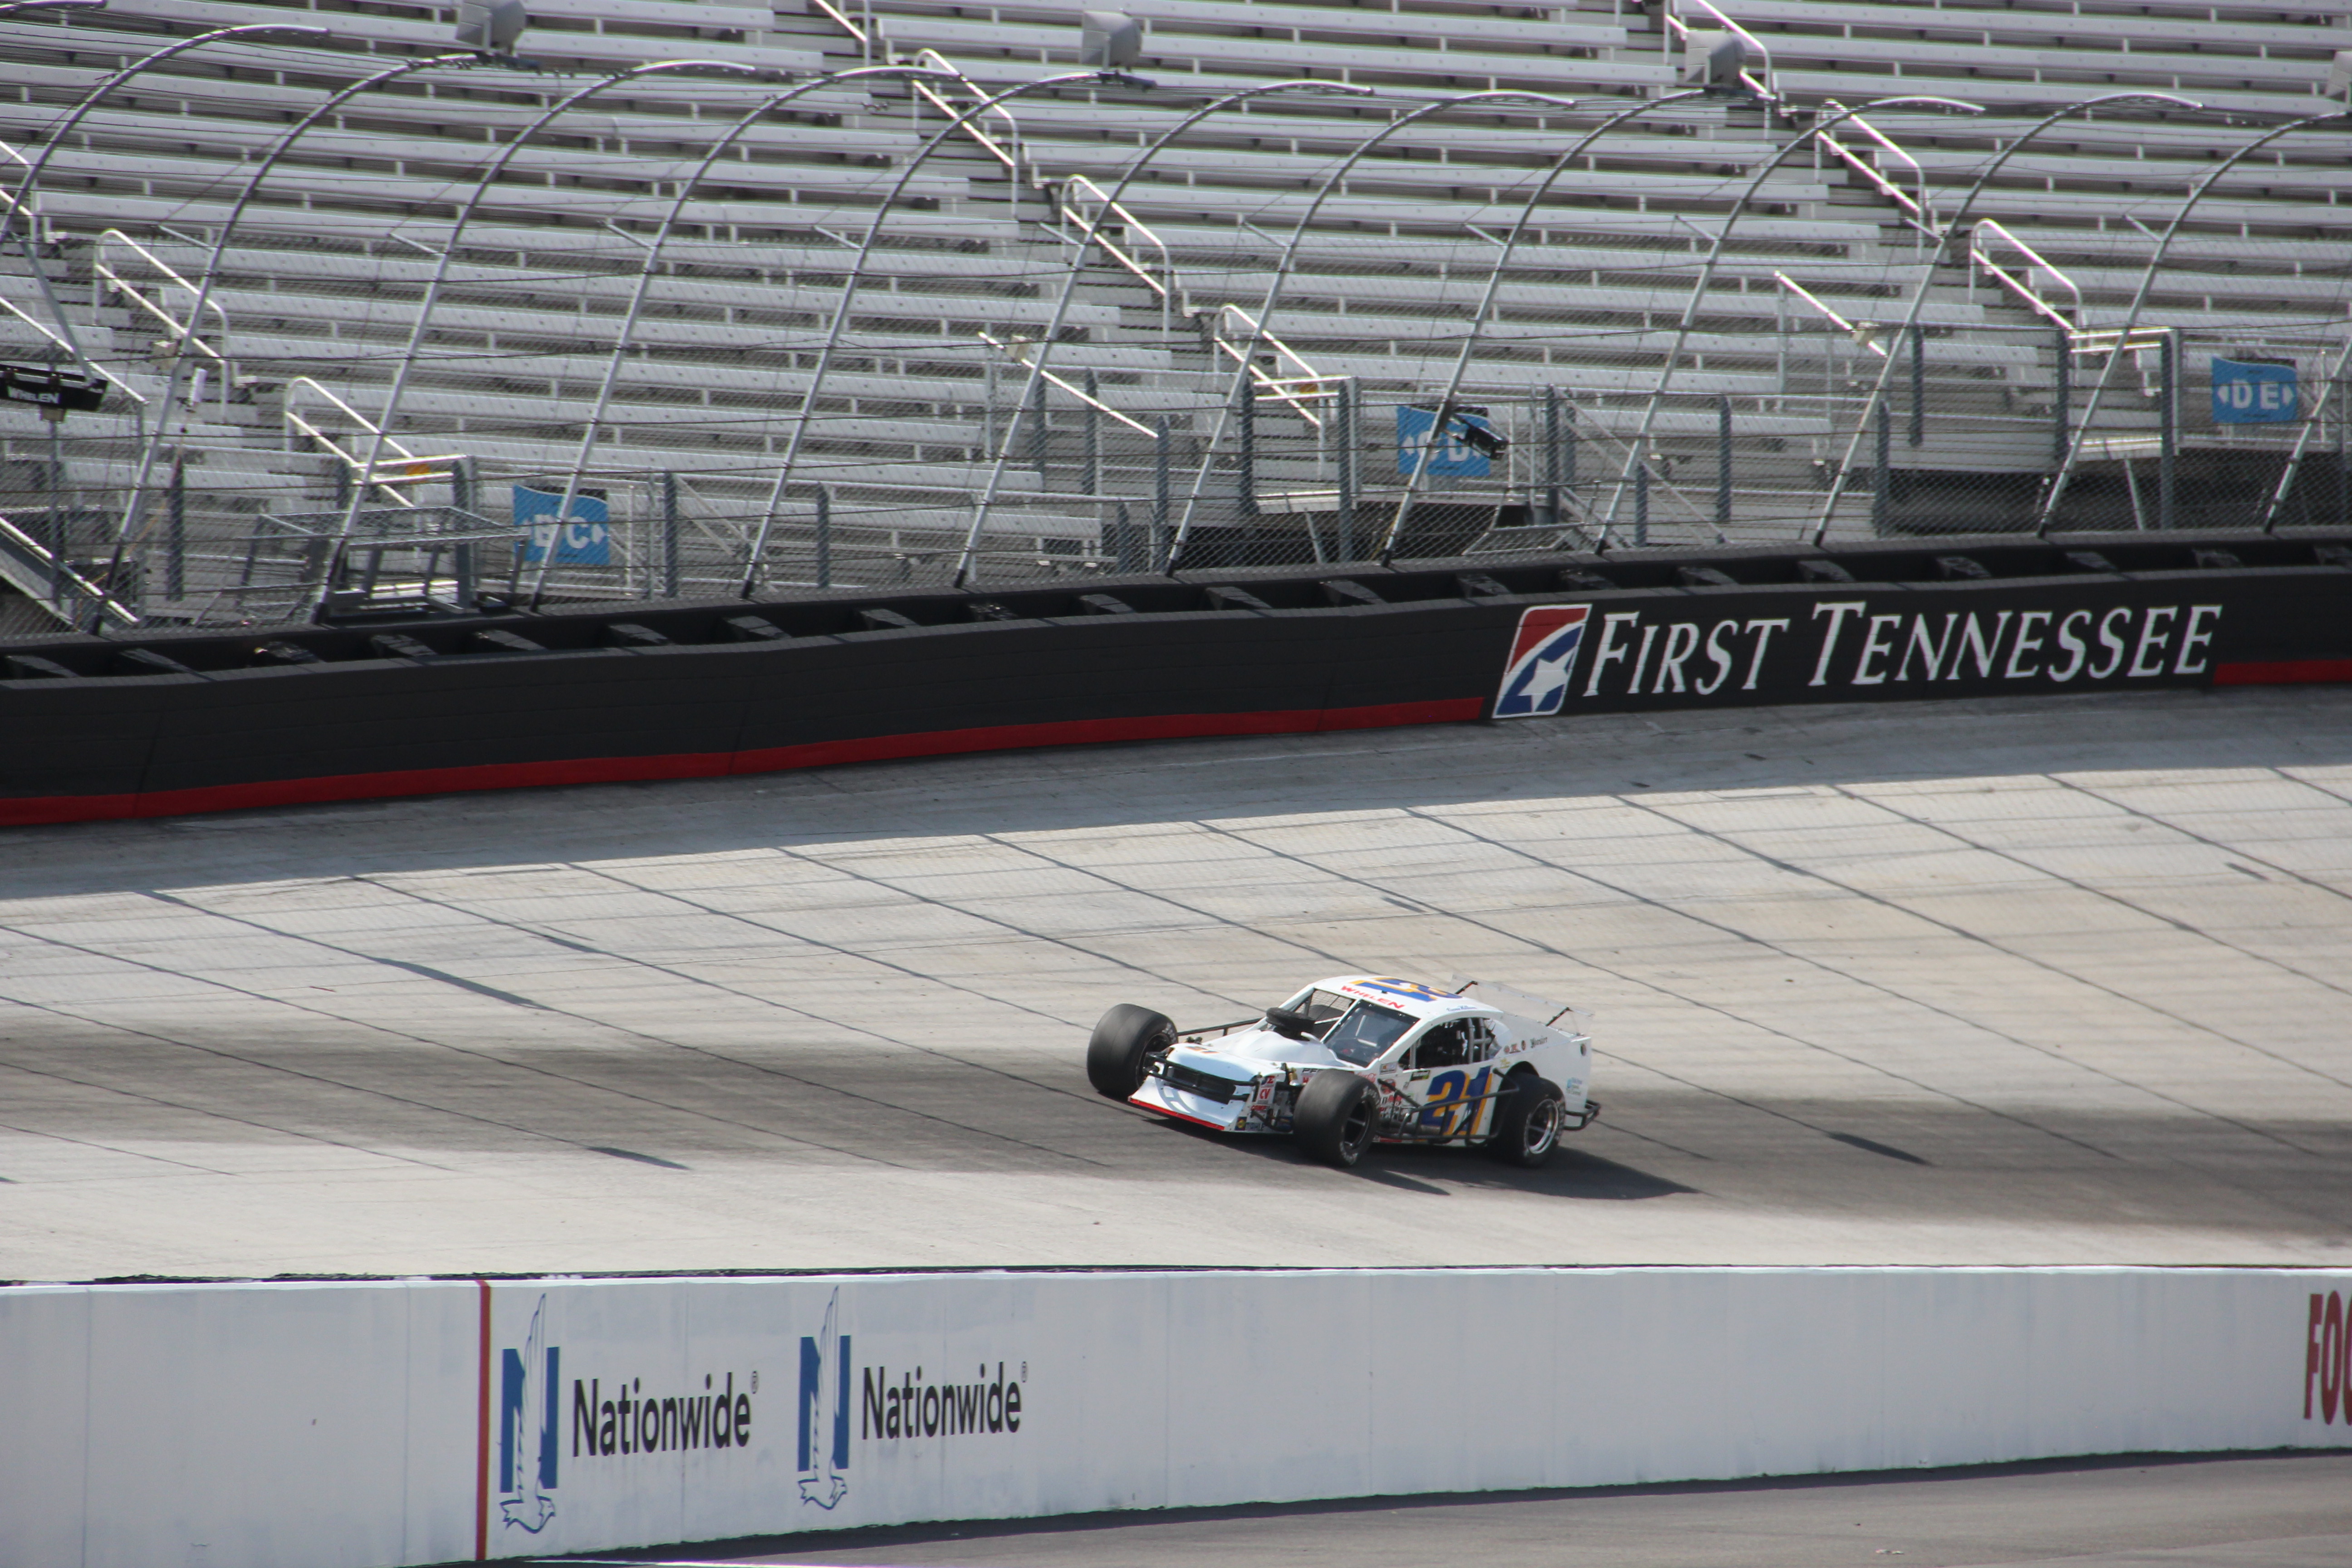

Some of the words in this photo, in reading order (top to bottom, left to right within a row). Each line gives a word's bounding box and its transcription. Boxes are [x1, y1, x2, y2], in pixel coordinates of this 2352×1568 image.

[1582, 611, 1789, 697] FIRST
[1808, 600, 2223, 687] TENNESSEE
[1340, 985, 1406, 1009] WHELEN
[1421, 1065, 1493, 1136] 21
[572, 1371, 752, 1458] Nationwide
[861, 1362, 1022, 1440] Nationwide
